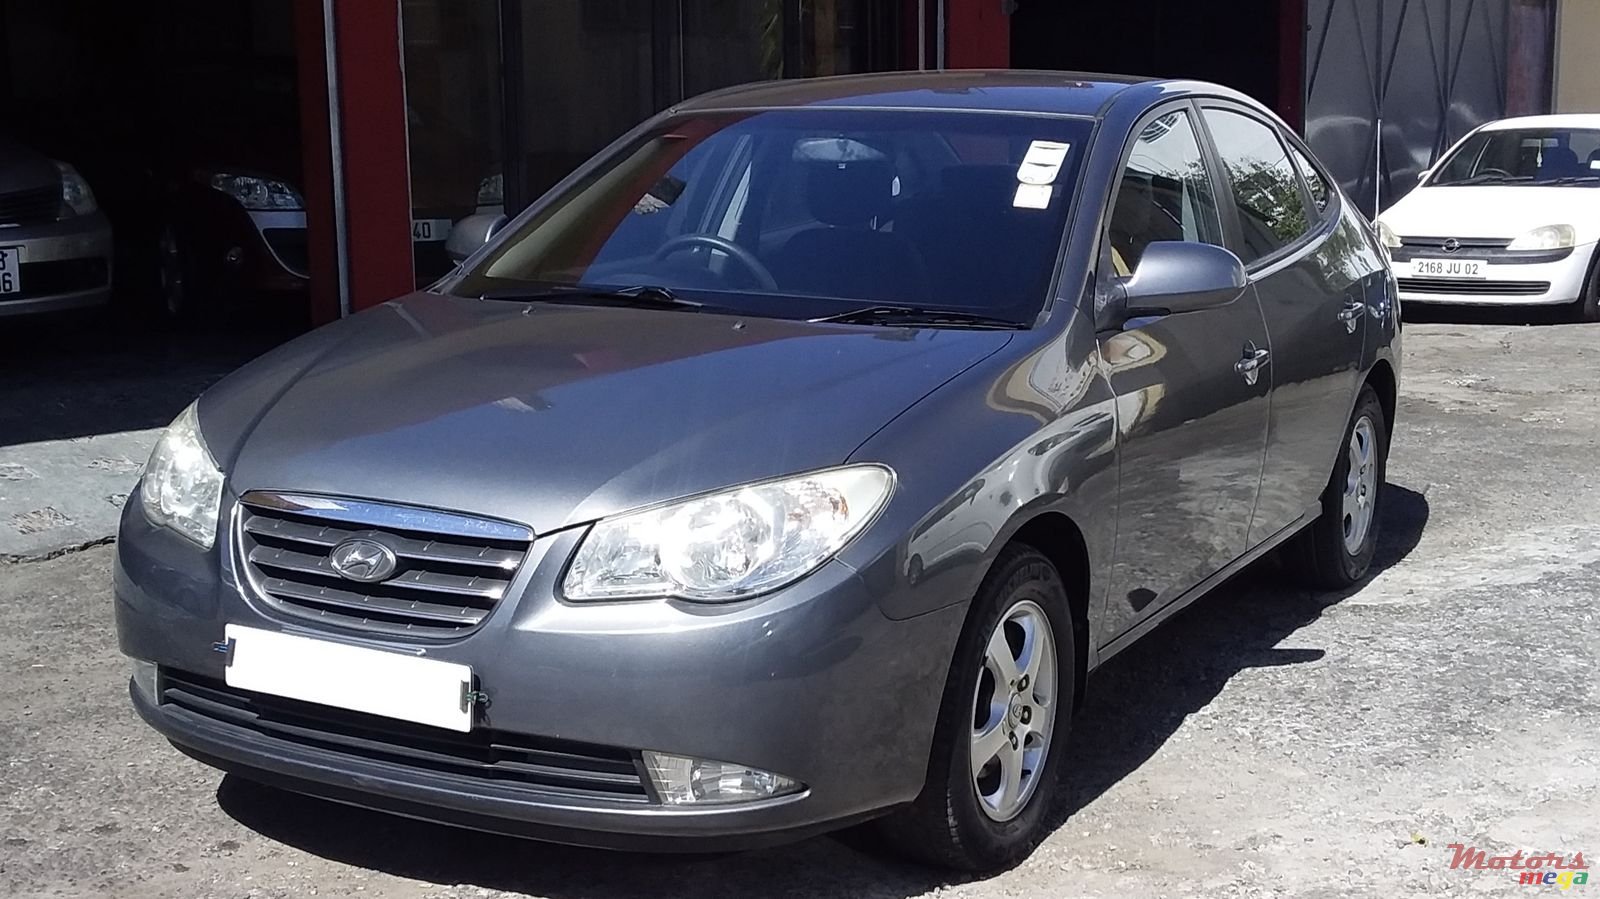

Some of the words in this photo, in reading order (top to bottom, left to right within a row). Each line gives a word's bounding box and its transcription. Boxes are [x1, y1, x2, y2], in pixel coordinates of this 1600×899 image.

[1418, 261, 1443, 274] 2168
[1446, 262, 1461, 274] JU
[1465, 263, 1479, 275] 02
